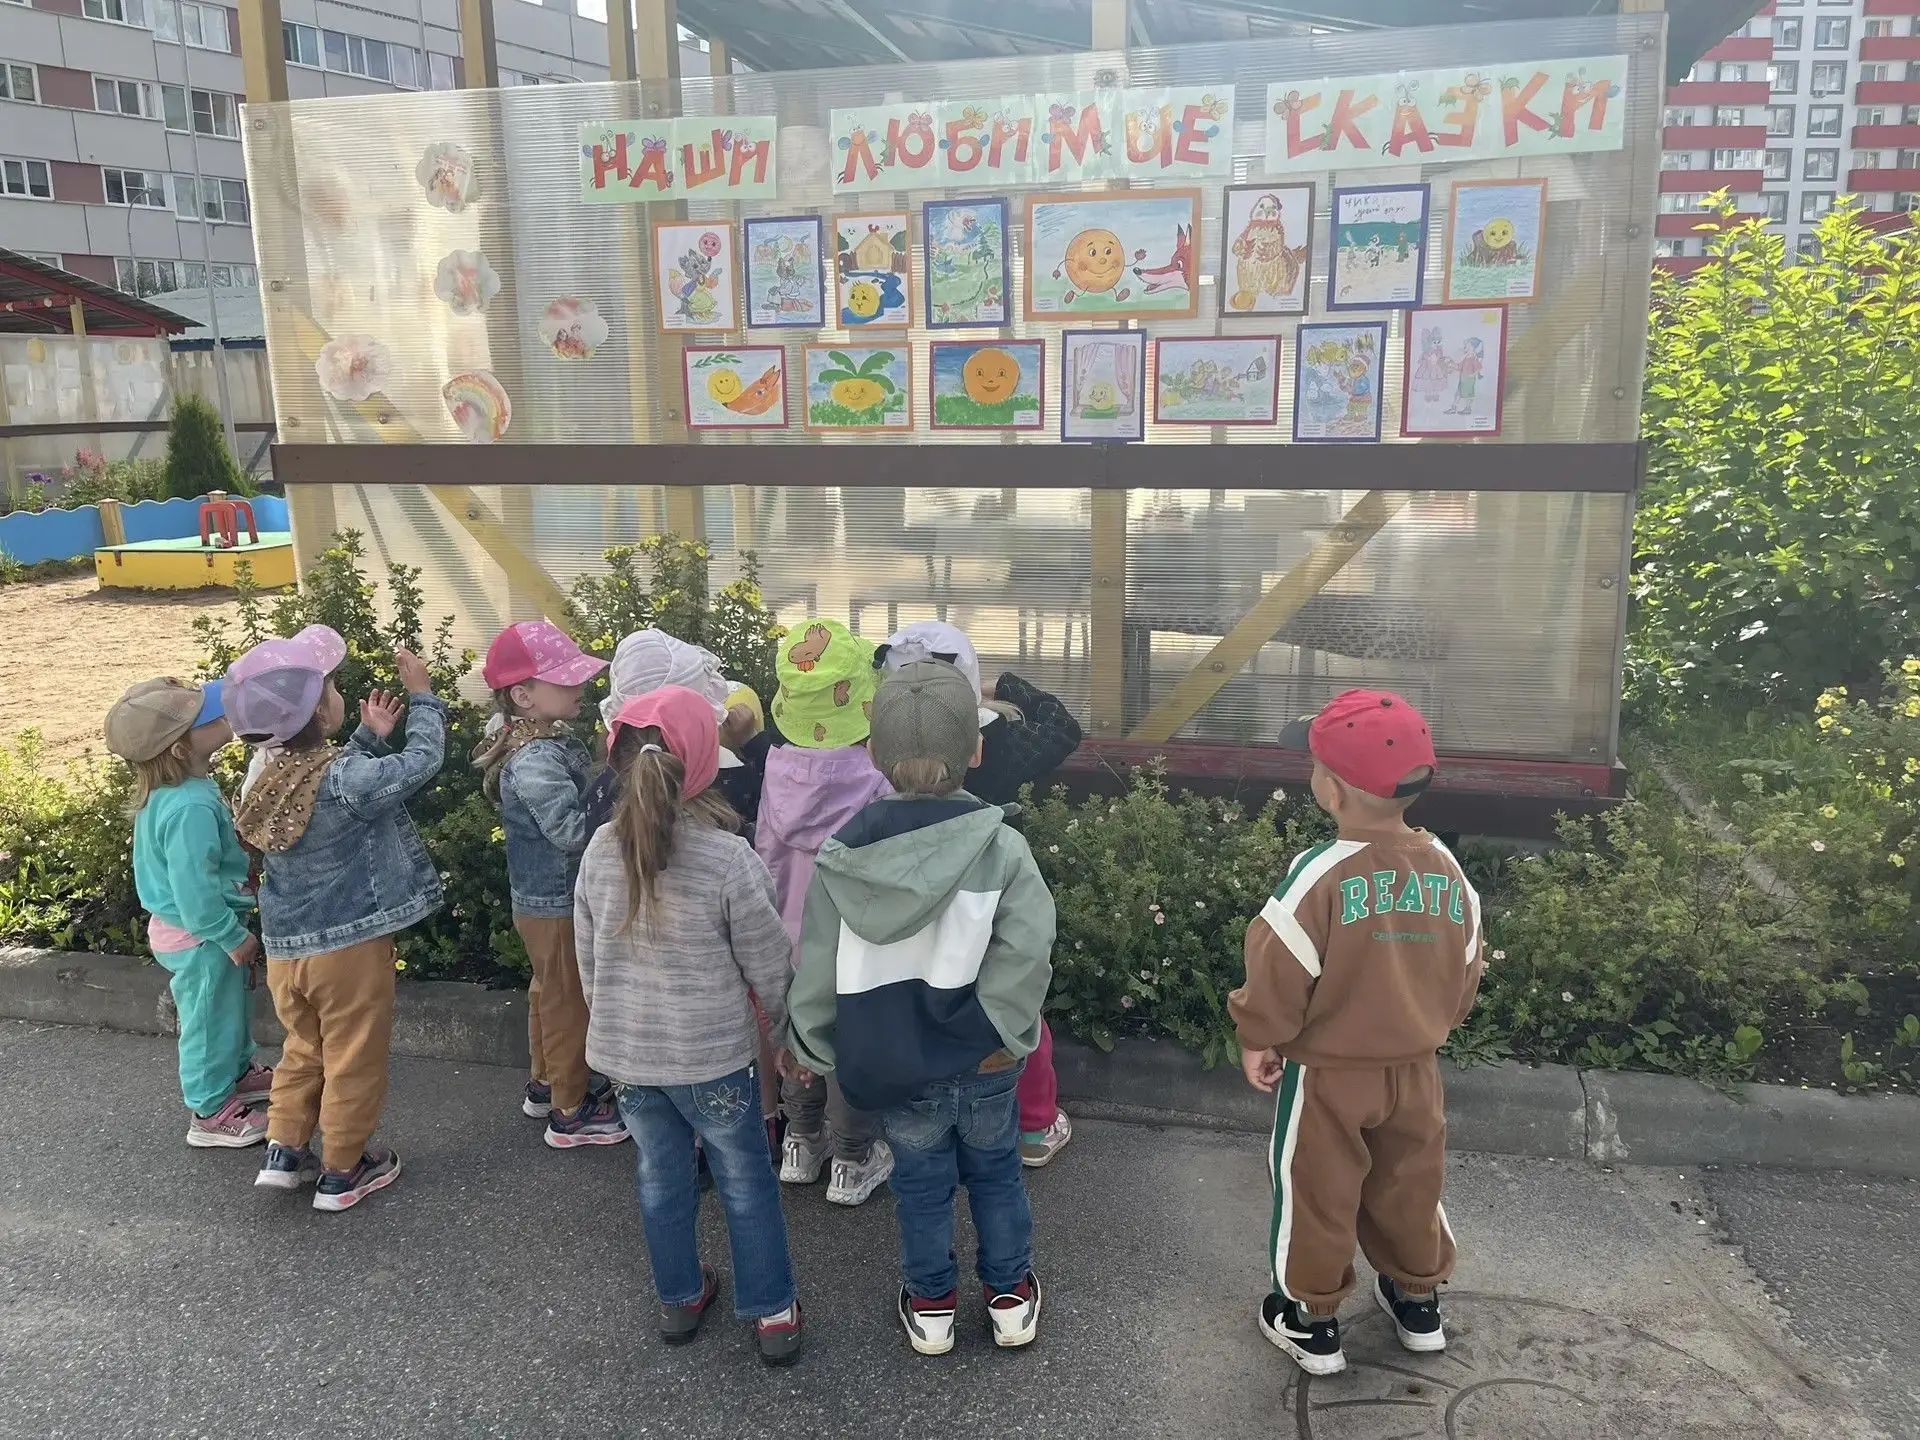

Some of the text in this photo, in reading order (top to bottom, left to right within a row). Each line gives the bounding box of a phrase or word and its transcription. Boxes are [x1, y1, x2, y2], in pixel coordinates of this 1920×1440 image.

[592, 70, 1613, 192] НАШИ ЛЮБИМЫЕ СКАЗКИ
